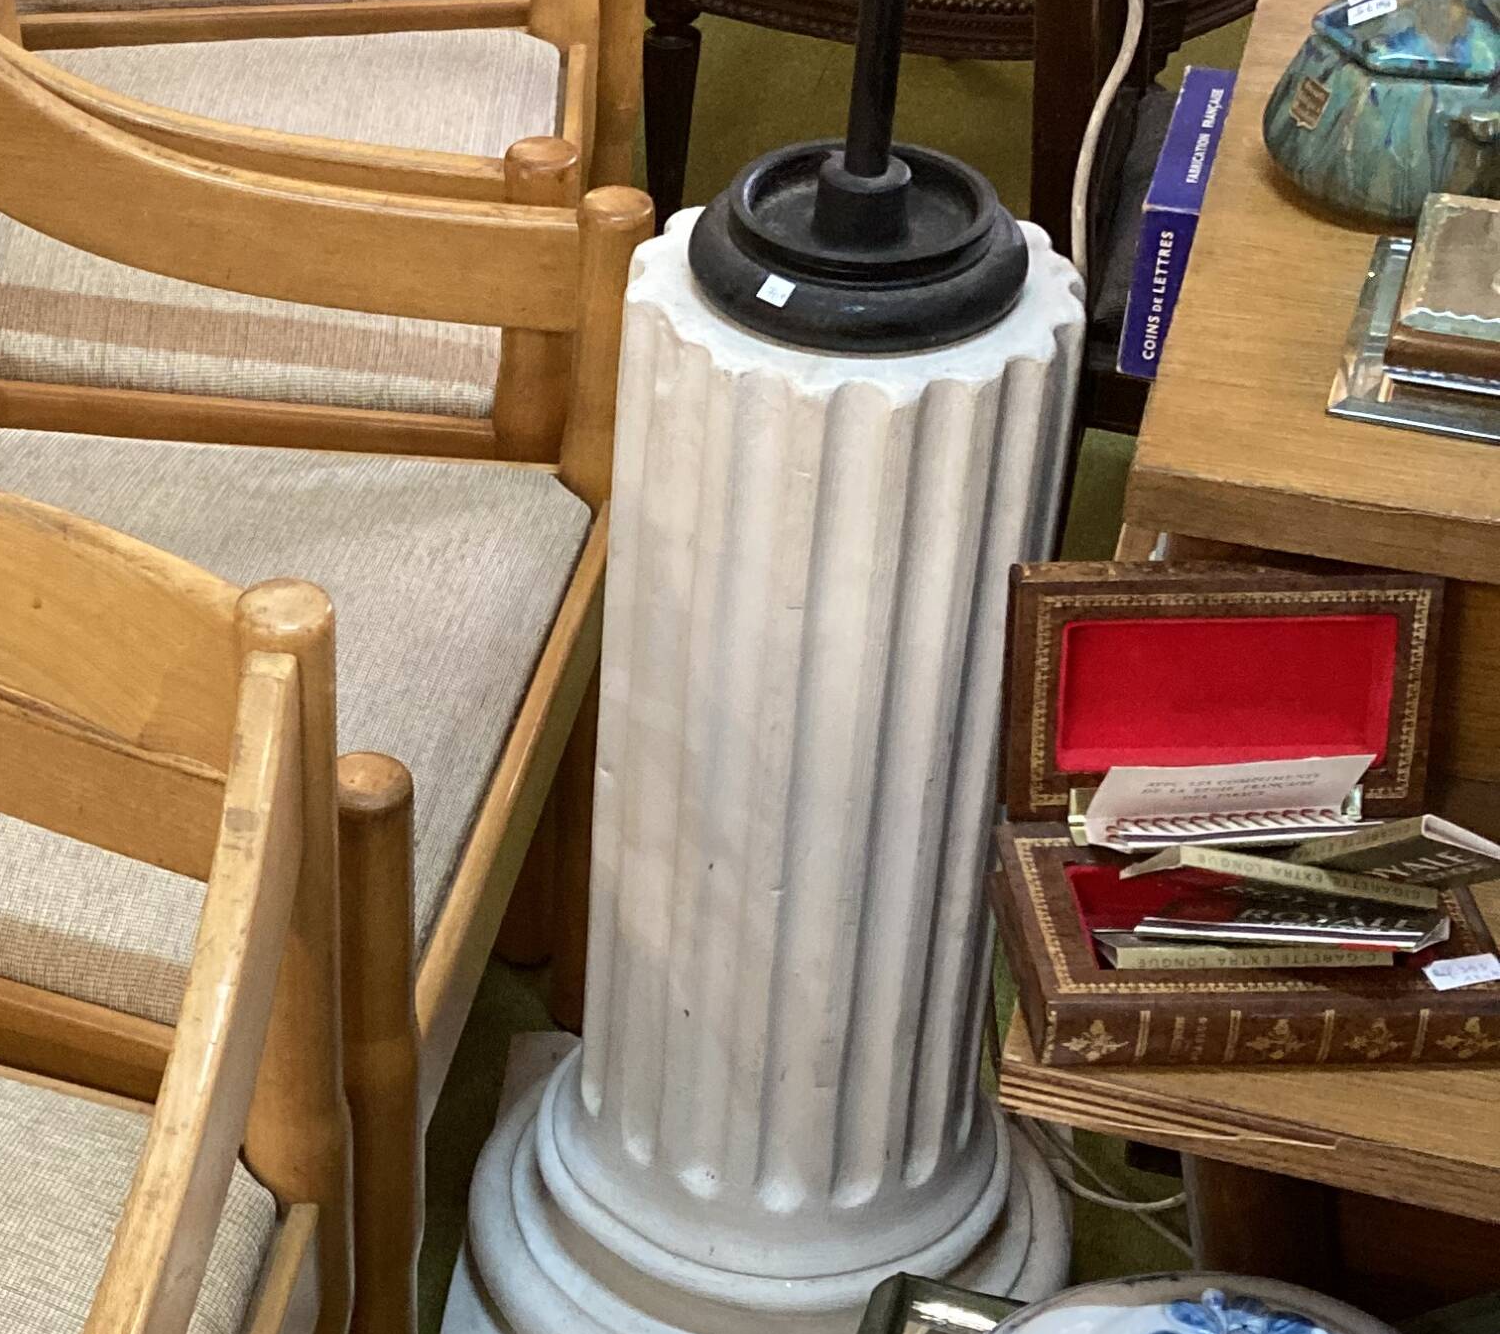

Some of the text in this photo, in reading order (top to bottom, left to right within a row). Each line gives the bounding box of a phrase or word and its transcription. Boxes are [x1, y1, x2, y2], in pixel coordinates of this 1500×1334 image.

[1186, 133, 1211, 184] FABRICATION
[1142, 230, 1174, 360] COINS DE LETTRES
[1198, 854, 1263, 875] LONGUE
[1274, 868, 1324, 883] EXTRA
[1138, 956, 1206, 967] LONGUE
[1218, 954, 1272, 965] EXTRA
